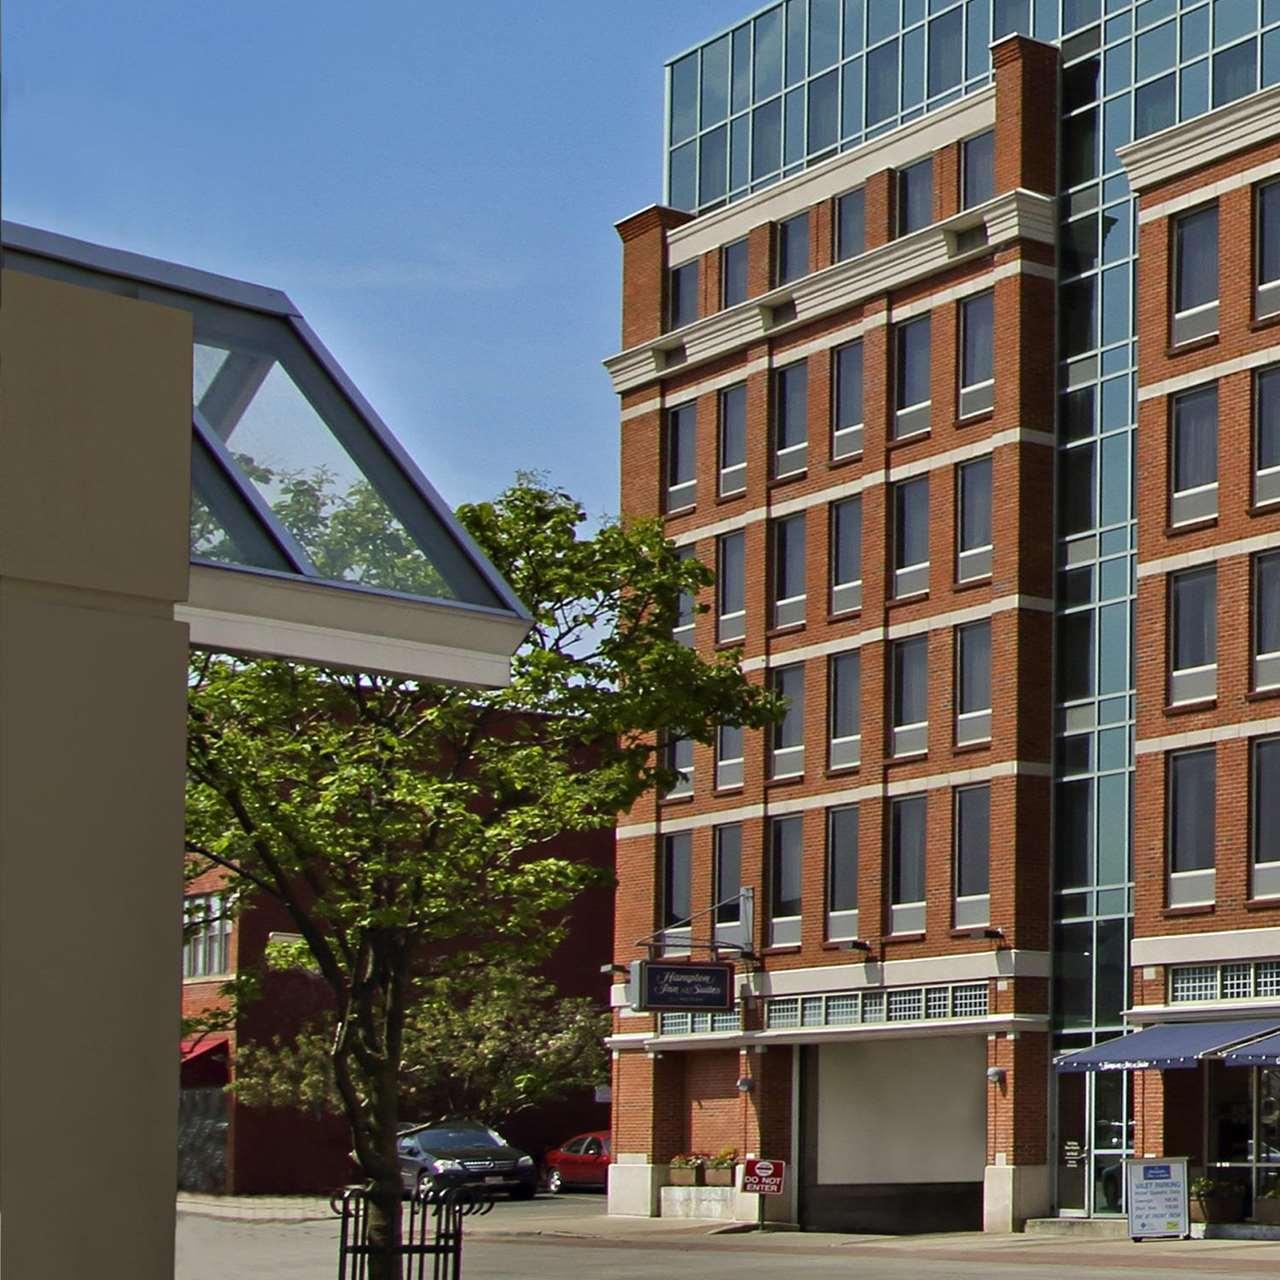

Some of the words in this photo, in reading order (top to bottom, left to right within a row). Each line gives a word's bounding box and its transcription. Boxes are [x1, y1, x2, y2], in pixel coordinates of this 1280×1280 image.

[745, 1176, 759, 1184] DO
[762, 1177, 781, 1185] NOT
[746, 1184, 778, 1192] ENTER
